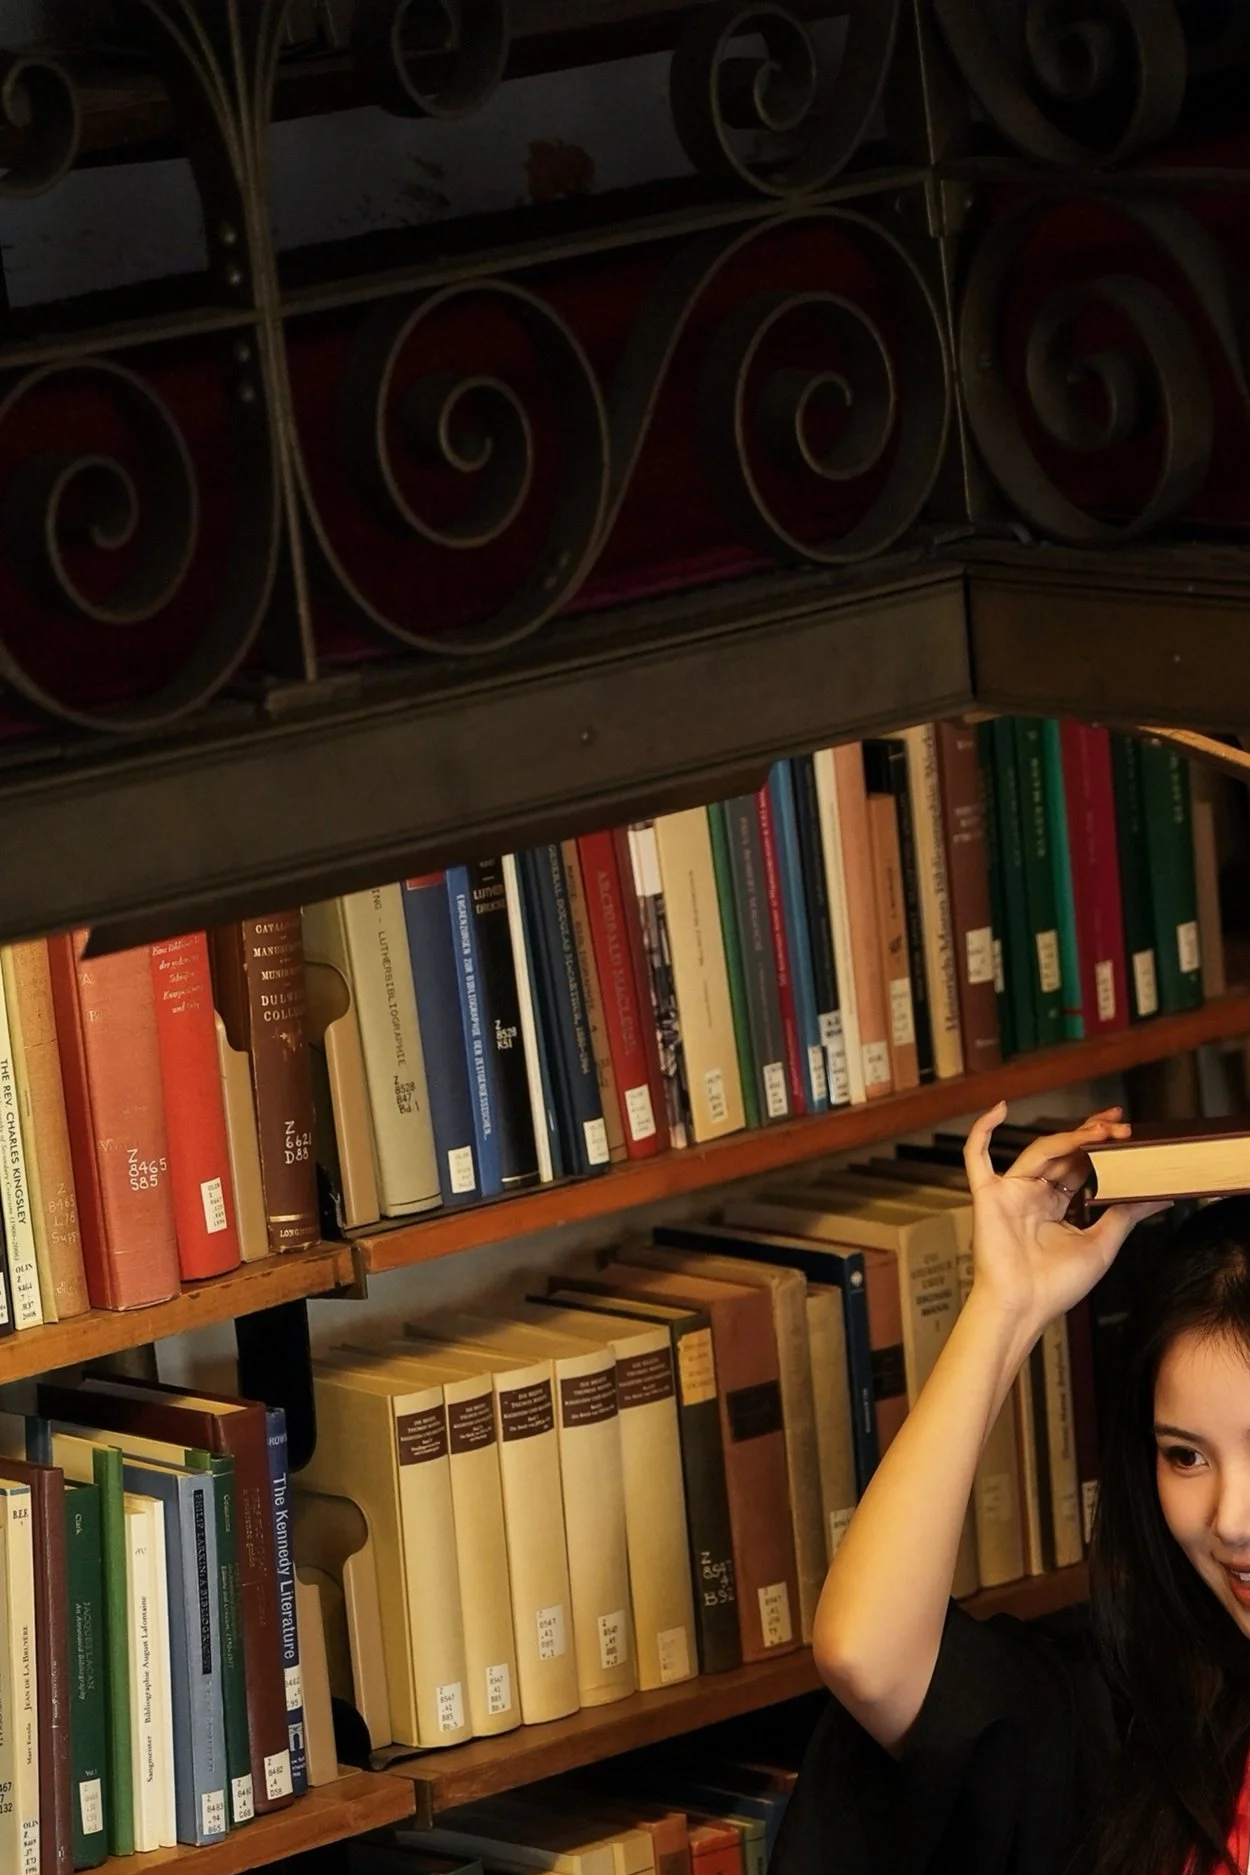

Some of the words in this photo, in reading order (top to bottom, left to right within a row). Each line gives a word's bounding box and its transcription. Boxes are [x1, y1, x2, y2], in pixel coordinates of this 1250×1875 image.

[597, 870, 622, 966] ARCHIBALD
[464, 958, 474, 973] ZUR
[378, 930, 407, 1065] LUTHERBIBLIOGRAPHIE
[467, 976, 481, 1036] BIBLIOGRAPHIE
[0, 1059, 10, 1082] THE
[3, 1084, 12, 1106] REV.
[7, 1111, 19, 1165] CHARLES
[285, 1120, 295, 1134] Z
[286, 1133, 311, 1149] 6621
[127, 1149, 138, 1164] Z
[129, 1158, 167, 1177] 8465
[285, 1148, 308, 1164] D88
[13, 1167, 26, 1225] KINGSLEY
[130, 1175, 158, 1191] S85
[15, 1265, 33, 1274] OLIN
[273, 1472, 287, 1507] The
[75, 1513, 83, 1534] Clark
[194, 1493, 204, 1529] PHILIP
[276, 1509, 291, 1576] Kennedy
[701, 1552, 711, 1564] Z
[83, 1601, 93, 1647] JACQUES
[141, 1596, 149, 1639] Lafontaine
[279, 1580, 295, 1660] Literature
[86, 1648, 95, 1690] LACAN
[142, 1641, 150, 1668] August
[77, 1650, 86, 1700] Bibliography
[142, 1671, 152, 1723] Bibliographie
[145, 1736, 154, 1783] Sangmeister
